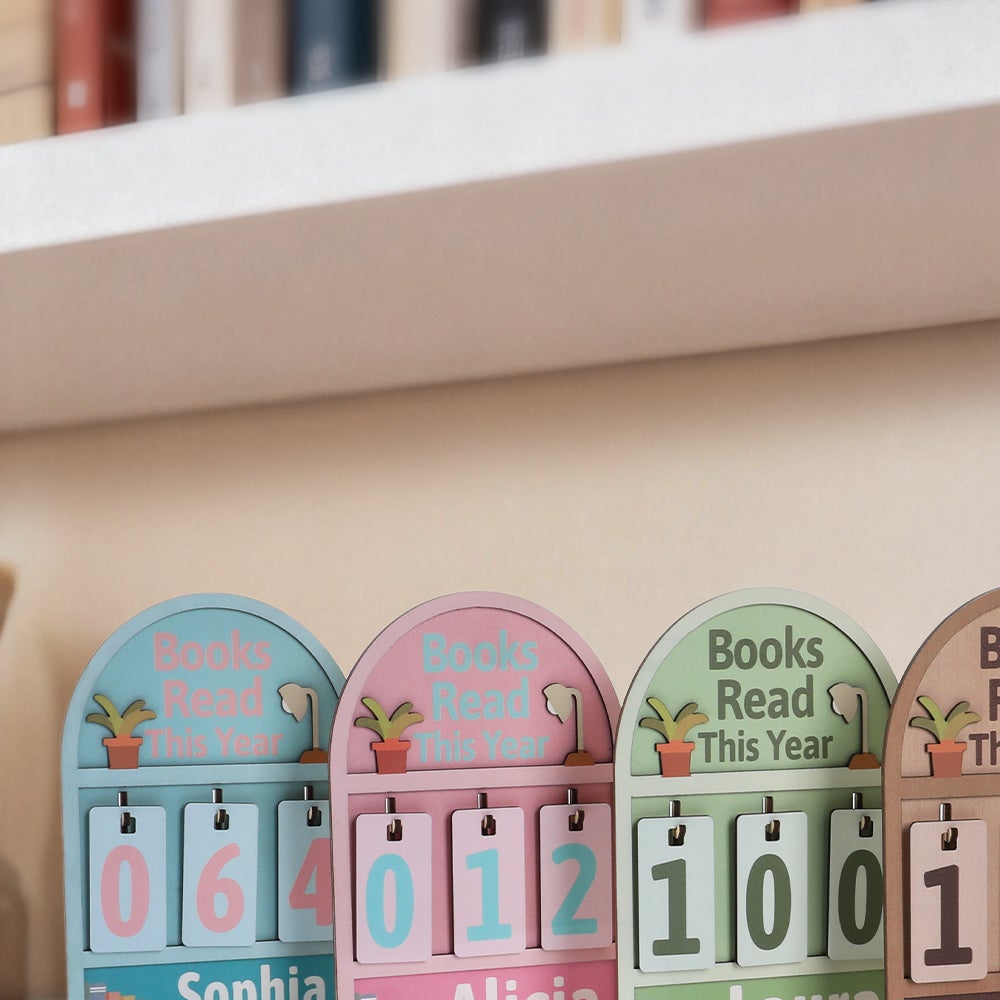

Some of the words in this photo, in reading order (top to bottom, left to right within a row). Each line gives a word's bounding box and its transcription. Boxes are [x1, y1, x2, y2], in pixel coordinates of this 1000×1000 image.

[153, 629, 272, 672] Books
[422, 629, 539, 673] Books
[708, 625, 824, 670] Books
[163, 676, 264, 718] Read
[431, 677, 530, 721] Read
[717, 674, 814, 720] Read
[144, 728, 199, 758] This
[214, 727, 283, 757] Year
[413, 731, 475, 763] This
[481, 730, 549, 759] Year
[698, 730, 759, 763] This
[766, 730, 833, 760] Year
